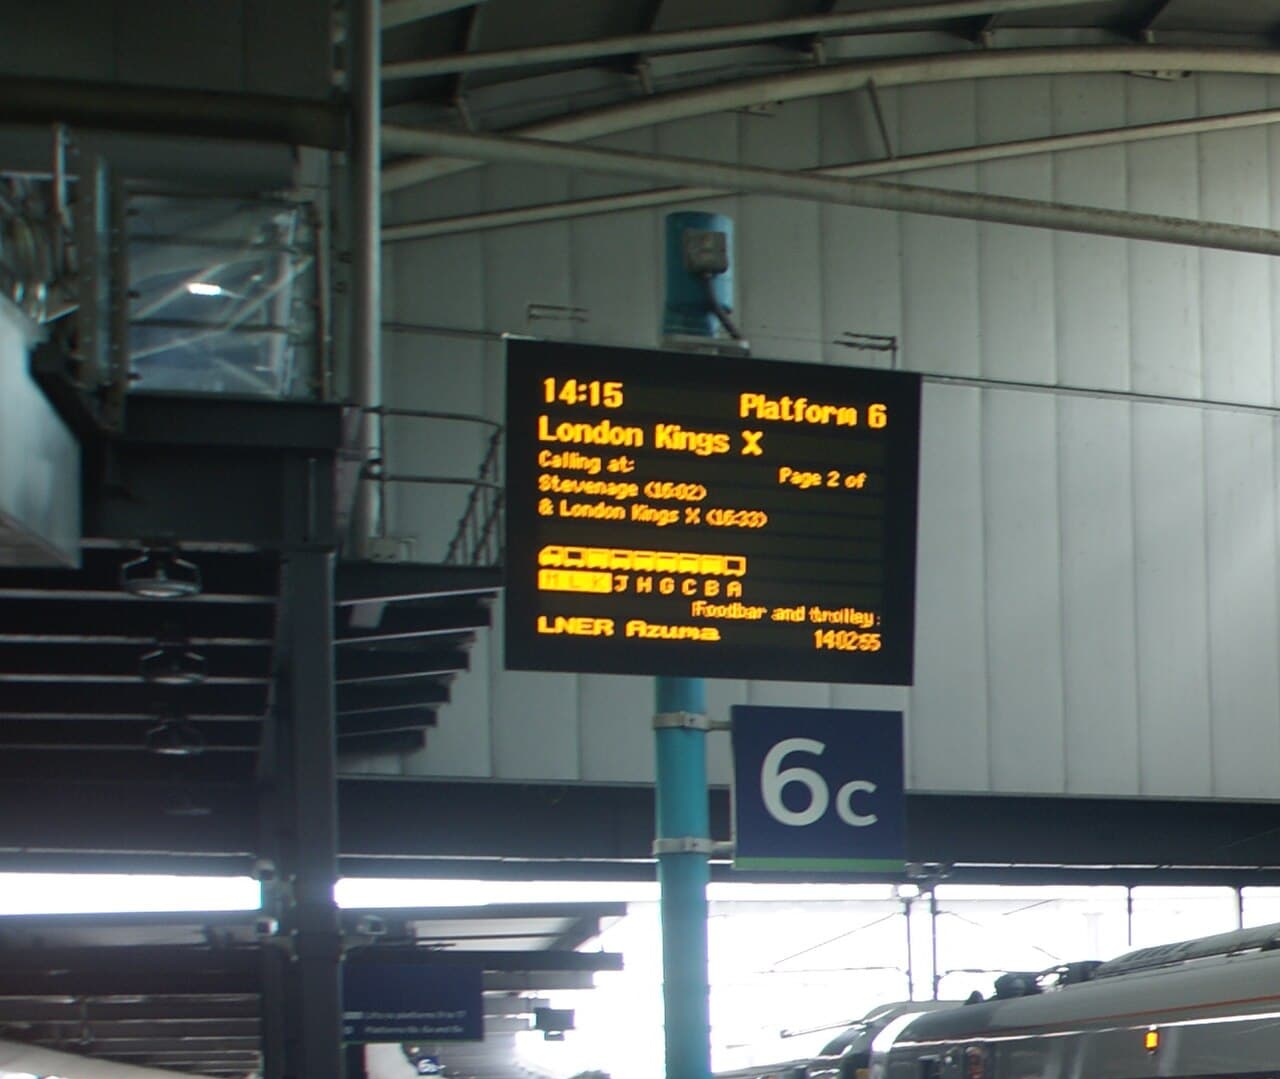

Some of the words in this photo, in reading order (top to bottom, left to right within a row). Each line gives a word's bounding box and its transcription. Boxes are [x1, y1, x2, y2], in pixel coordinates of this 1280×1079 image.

[544, 377, 624, 408] 14:15
[739, 392, 858, 427] Platform
[867, 403, 887, 428] 6
[538, 415, 644, 448] London
[655, 423, 731, 456] Kings
[741, 430, 763, 456] X
[538, 450, 602, 474] Calling
[538, 474, 639, 500] Stevenage
[778, 467, 822, 489] Page
[826, 470, 840, 487] 2
[844, 472, 867, 488] of
[559, 499, 626, 520] London
[631, 503, 680, 526] Kings
[685, 507, 700, 524] X
[636, 576, 652, 593] H
[681, 578, 697, 595] C
[704, 580, 720, 597] B
[726, 581, 742, 597] A
[771, 606, 805, 622] and
[537, 616, 614, 637] LNER
[625, 620, 721, 641] Azuma
[761, 738, 878, 826] 6c
